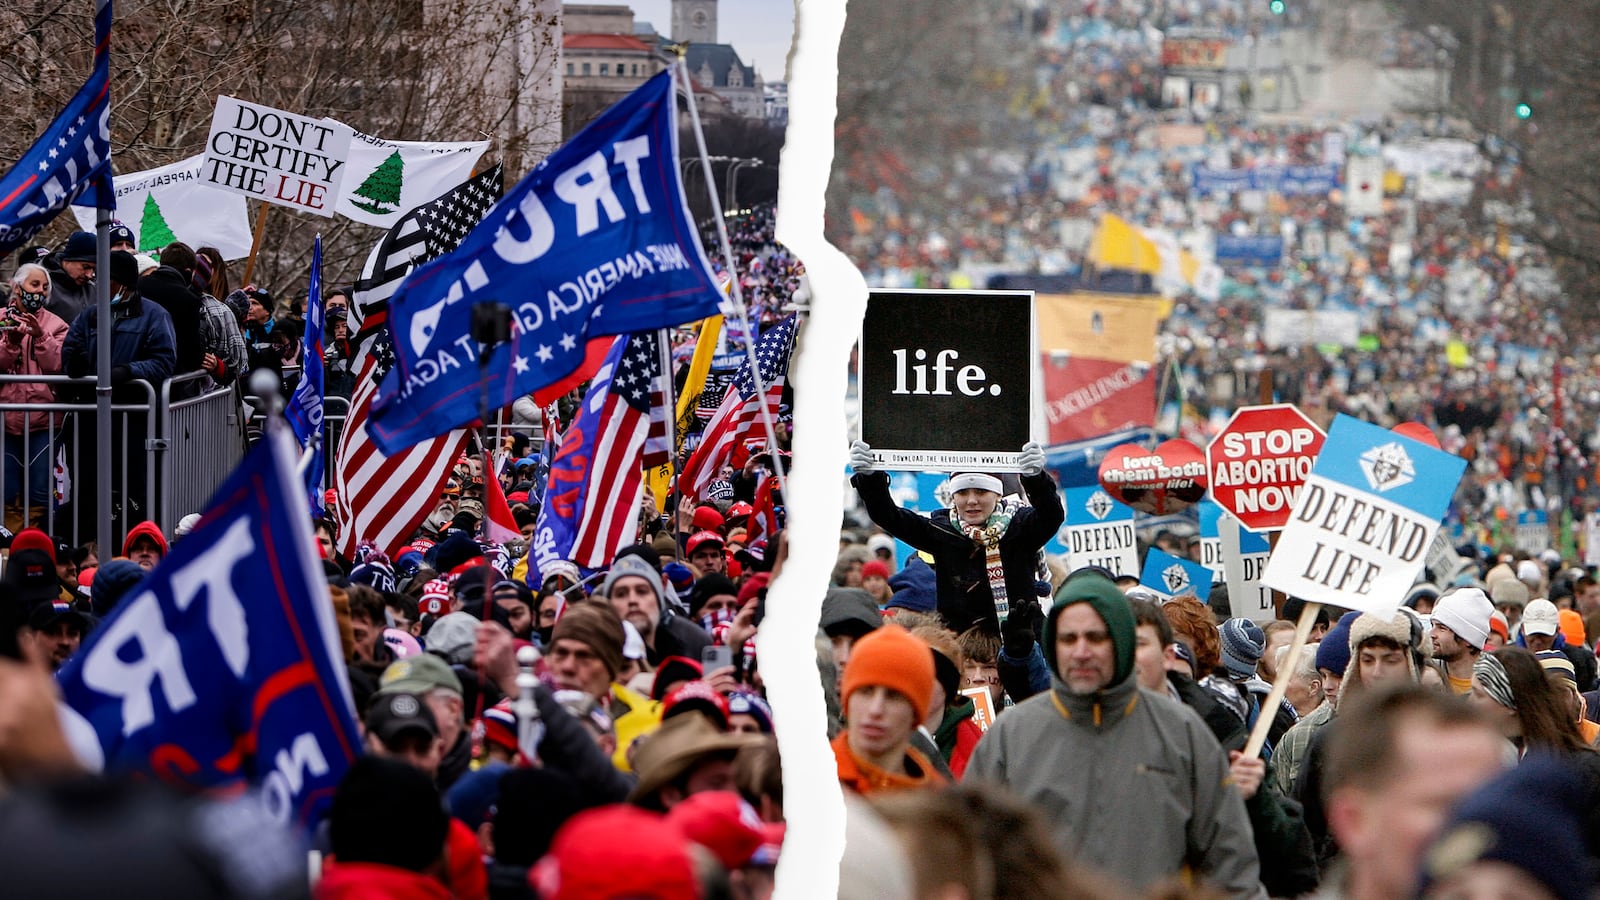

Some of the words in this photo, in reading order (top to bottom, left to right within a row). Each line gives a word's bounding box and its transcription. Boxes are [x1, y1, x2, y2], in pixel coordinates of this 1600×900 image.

[233, 105, 334, 152] DON'T
[212, 131, 345, 184] CERTIFY
[207, 157, 268, 195] THE
[274, 172, 326, 211] LIE
[892, 348, 1002, 397] life.
[892, 454, 924, 463] DOWNLOAD
[926, 455, 938, 463] THE
[940, 455, 977, 464] REVOLUTION
[1223, 428, 1315, 458] STOP
[1103, 468, 1156, 483] them
[1157, 462, 1206, 479] both
[1122, 455, 1163, 470] love
[1166, 478, 1195, 489] life!
[1072, 525, 1133, 554] DEFEND
[1297, 483, 1429, 564] DEFEND
[1302, 542, 1382, 596] LIFE
